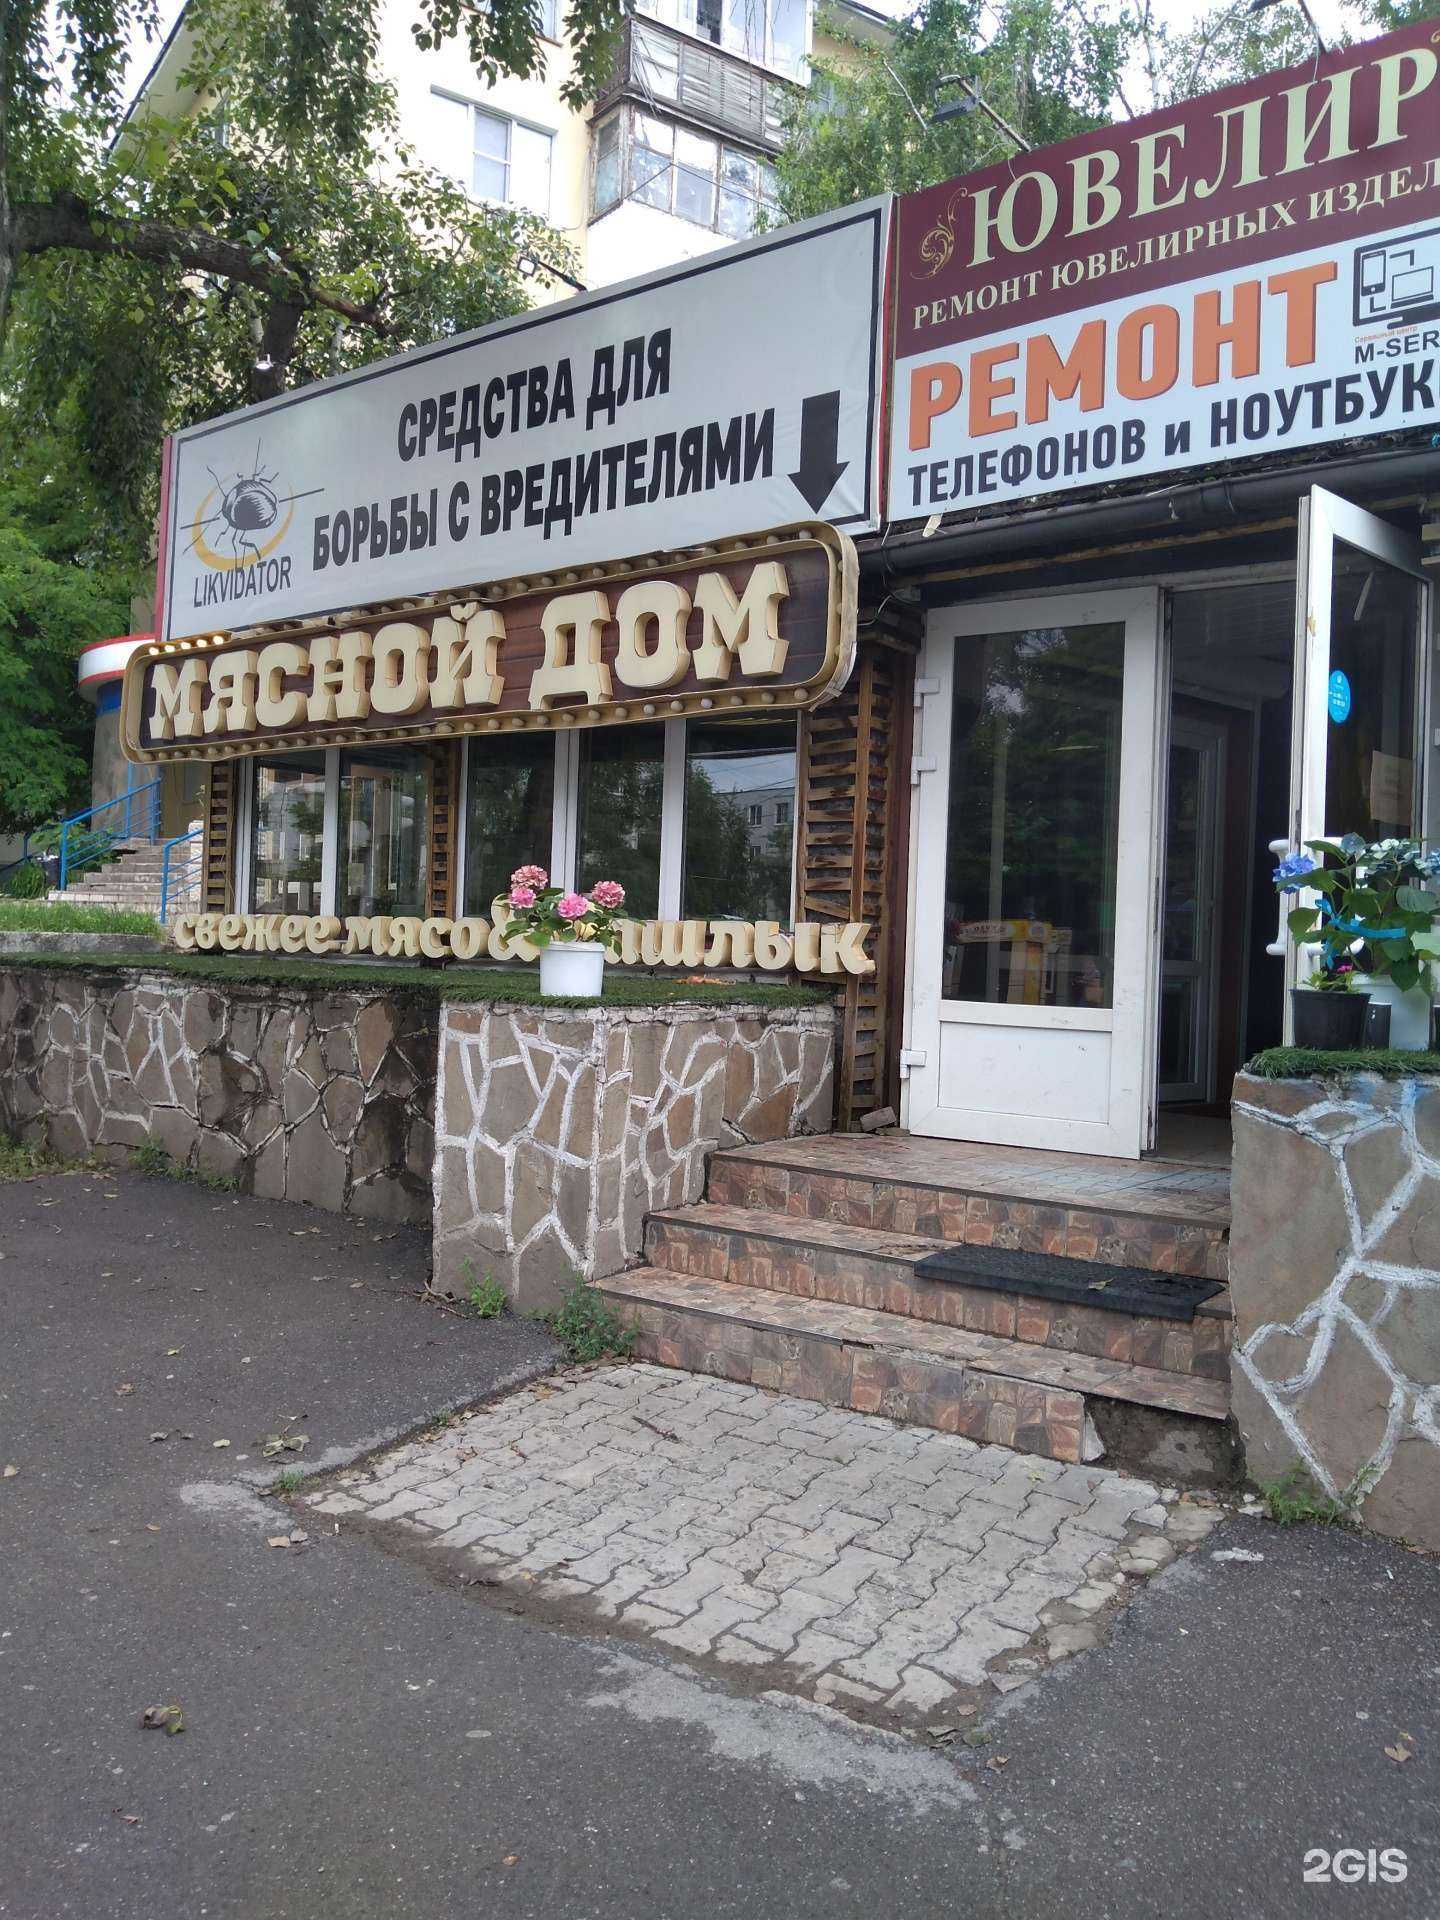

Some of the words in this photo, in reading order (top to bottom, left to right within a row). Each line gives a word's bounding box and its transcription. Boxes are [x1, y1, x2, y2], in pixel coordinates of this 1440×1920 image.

[966, 48, 1438, 268] ЮВЕЛИР
[913, 272, 1043, 330] РЕМОНТ
[1050, 198, 1297, 290] ЮВЕЛИРНЫХ
[398, 358, 575, 463] СРЕДСТВА
[585, 327, 672, 429] ДЛЯ
[908, 261, 1338, 452] РЕМОНТ
[908, 417, 1146, 506] ТЕЛЕФОНОВ
[1210, 358, 1440, 448] НОУТБУК
[312, 488, 438, 571] БОРЬБЫ
[447, 480, 471, 543] С
[480, 408, 776, 540] ВРЕДИТЕЛЯМИ
[149, 603, 506, 740] МЯСНОЙ
[529, 561, 791, 711] ДОМ
[193, 556, 292, 608] LIKVIDATOR
